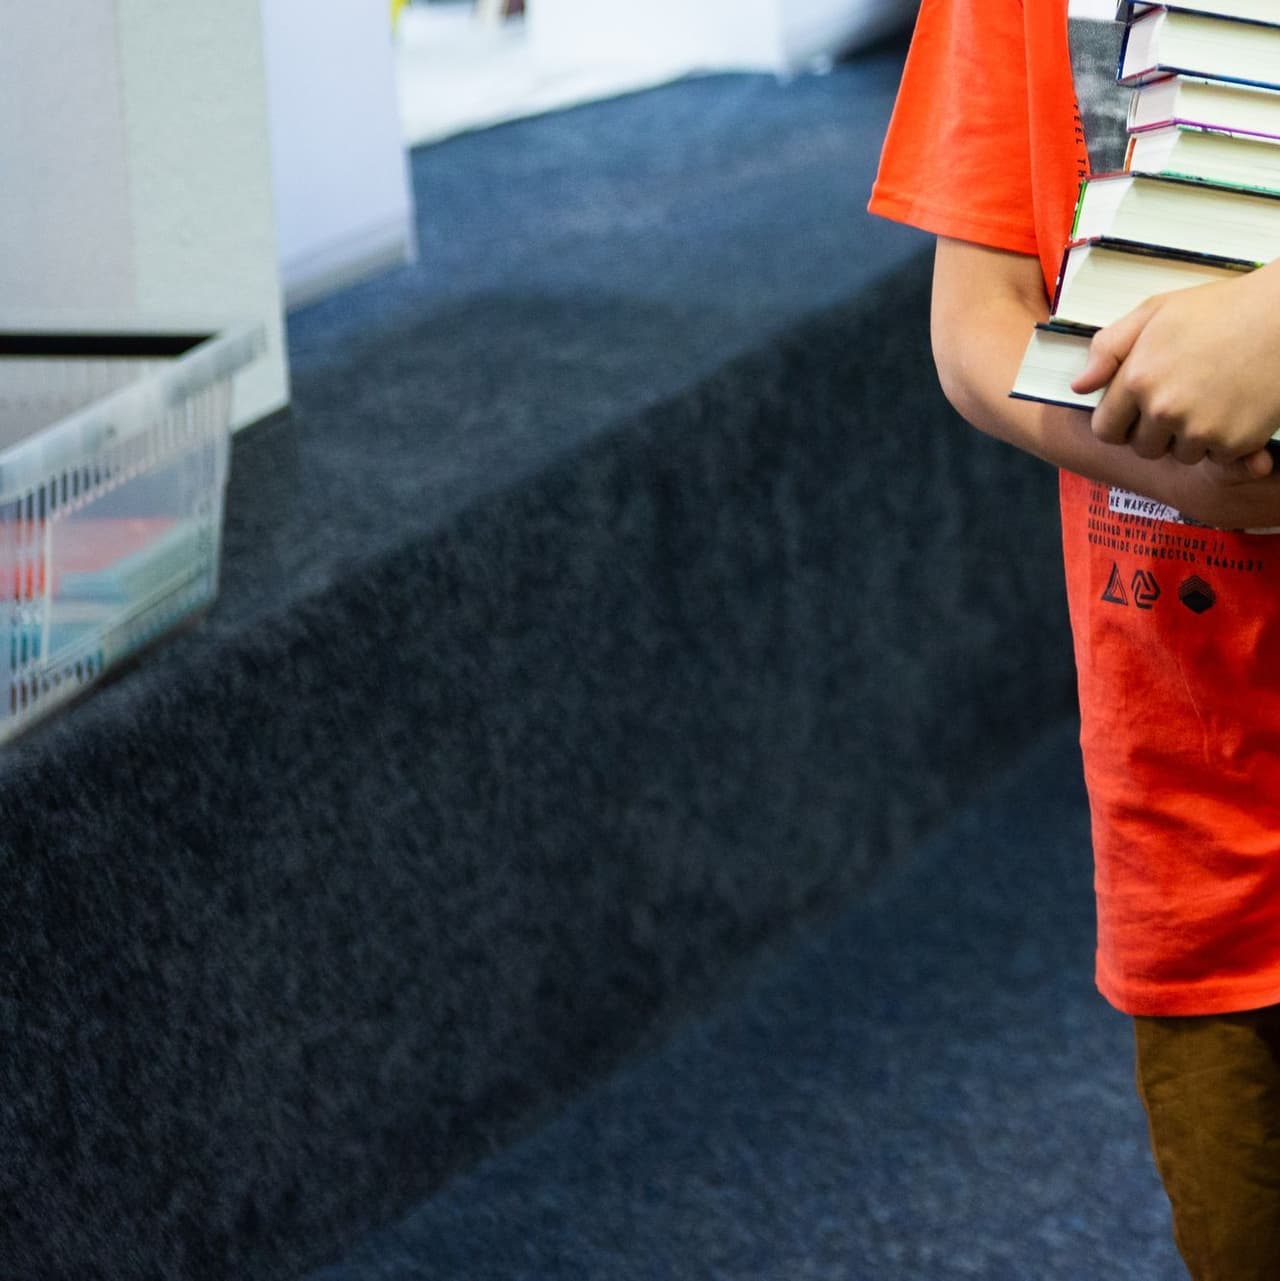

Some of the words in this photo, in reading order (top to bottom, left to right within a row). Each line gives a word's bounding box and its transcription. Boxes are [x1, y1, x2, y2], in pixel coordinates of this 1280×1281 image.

[1088, 533, 1130, 553] WORLDWIDE
[1125, 527, 1147, 542] WITH
[1151, 532, 1206, 553] ATTITUDE
